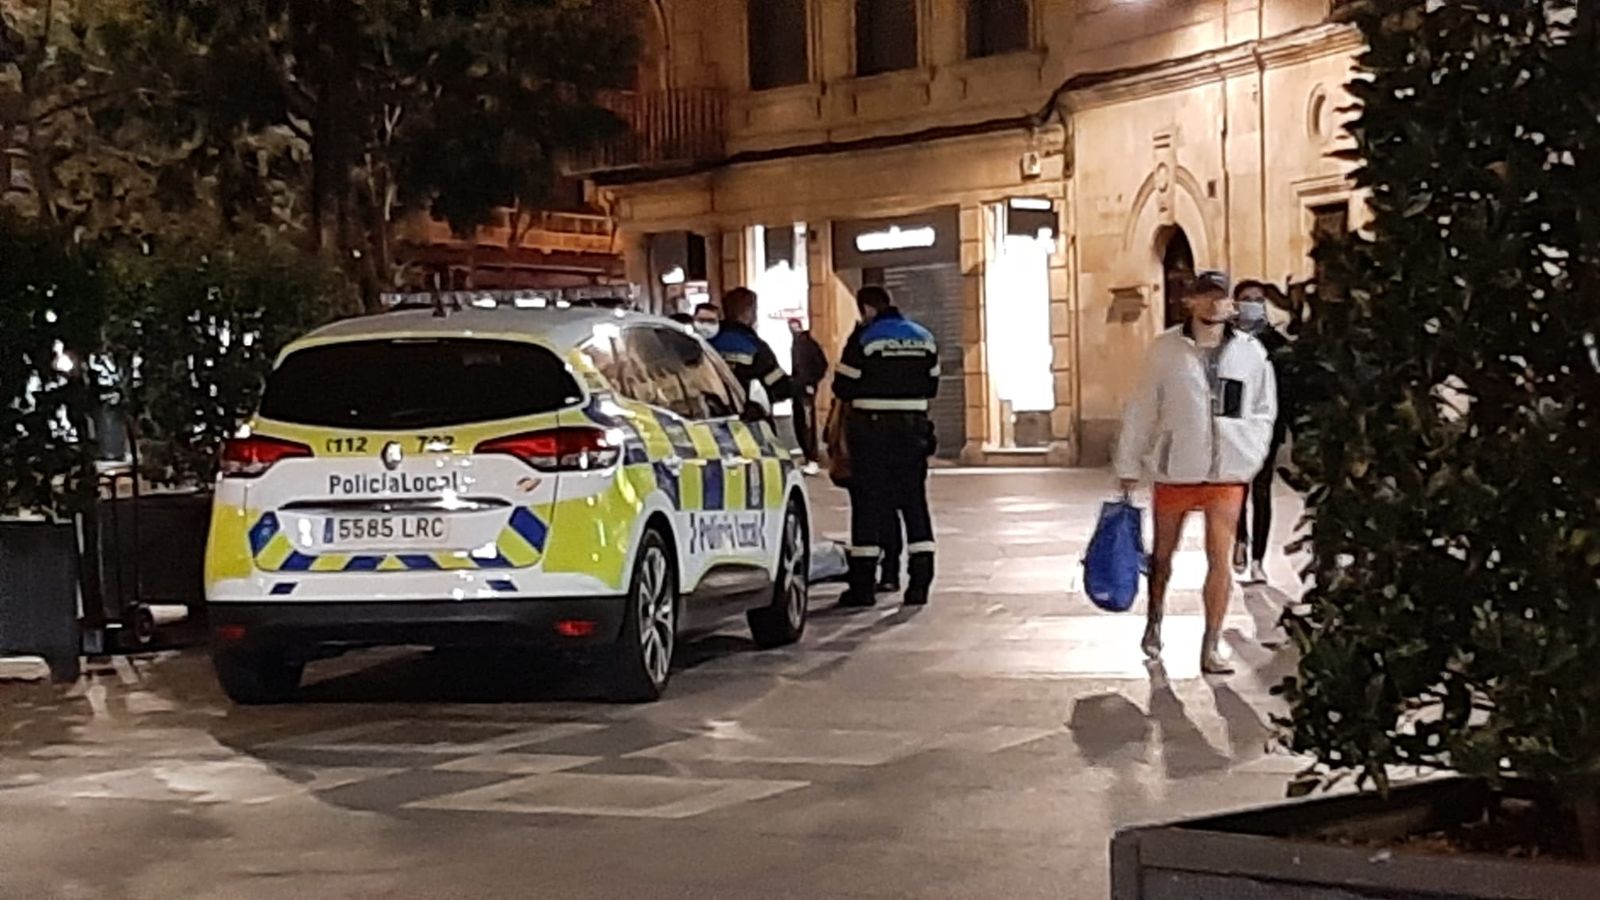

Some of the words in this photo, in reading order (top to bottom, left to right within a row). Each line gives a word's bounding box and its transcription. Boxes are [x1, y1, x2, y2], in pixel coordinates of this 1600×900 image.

[333, 437, 368, 453] 112
[339, 518, 393, 538] 5585
[402, 517, 444, 538] LRC
